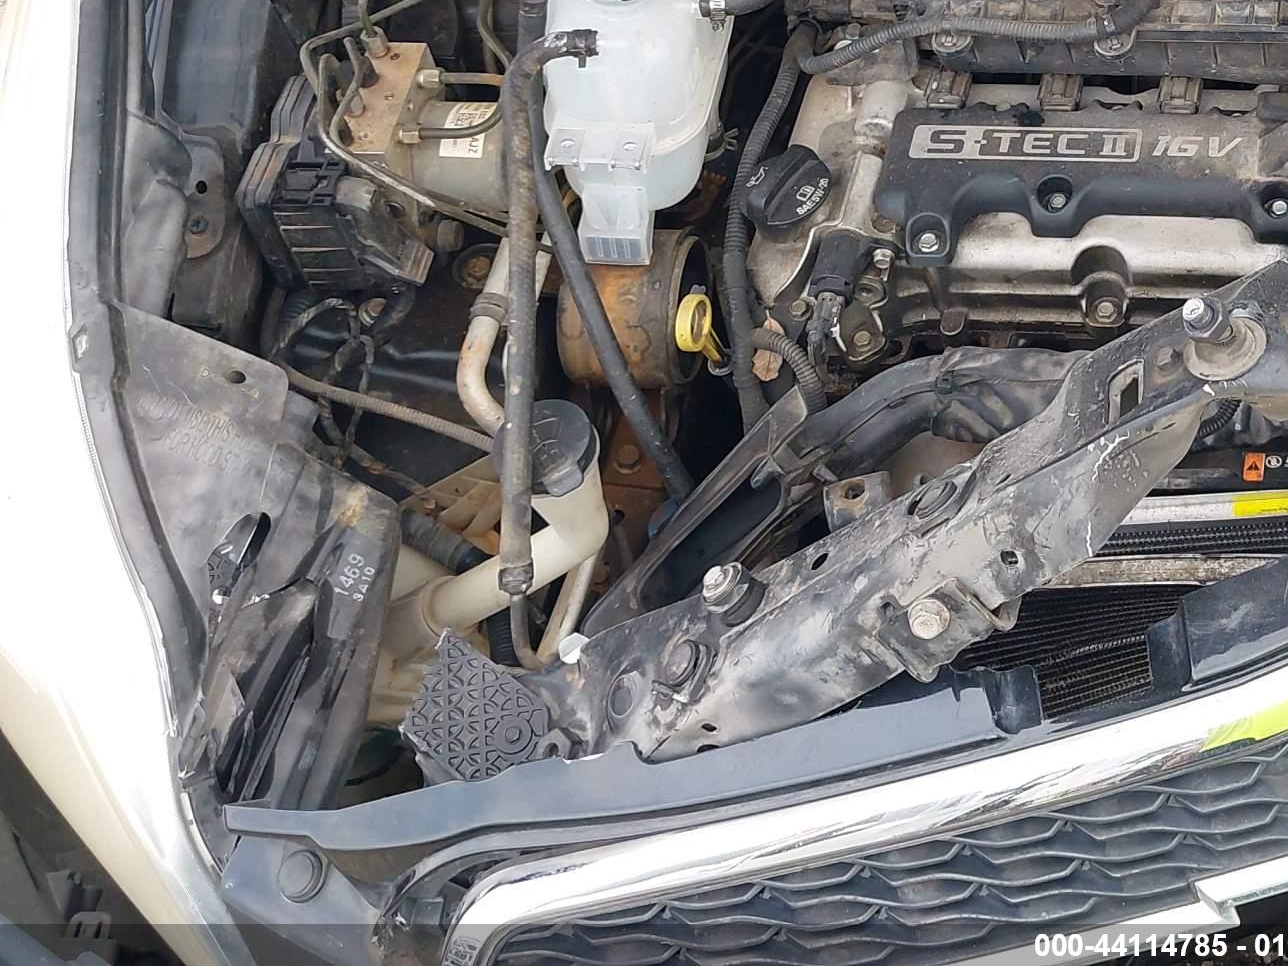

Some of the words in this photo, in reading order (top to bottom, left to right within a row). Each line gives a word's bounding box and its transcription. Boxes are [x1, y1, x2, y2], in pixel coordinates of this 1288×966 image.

[1150, 134, 1244, 158] 16V
[795, 199, 816, 216] SAE
[333, 552, 365, 596] 1469
